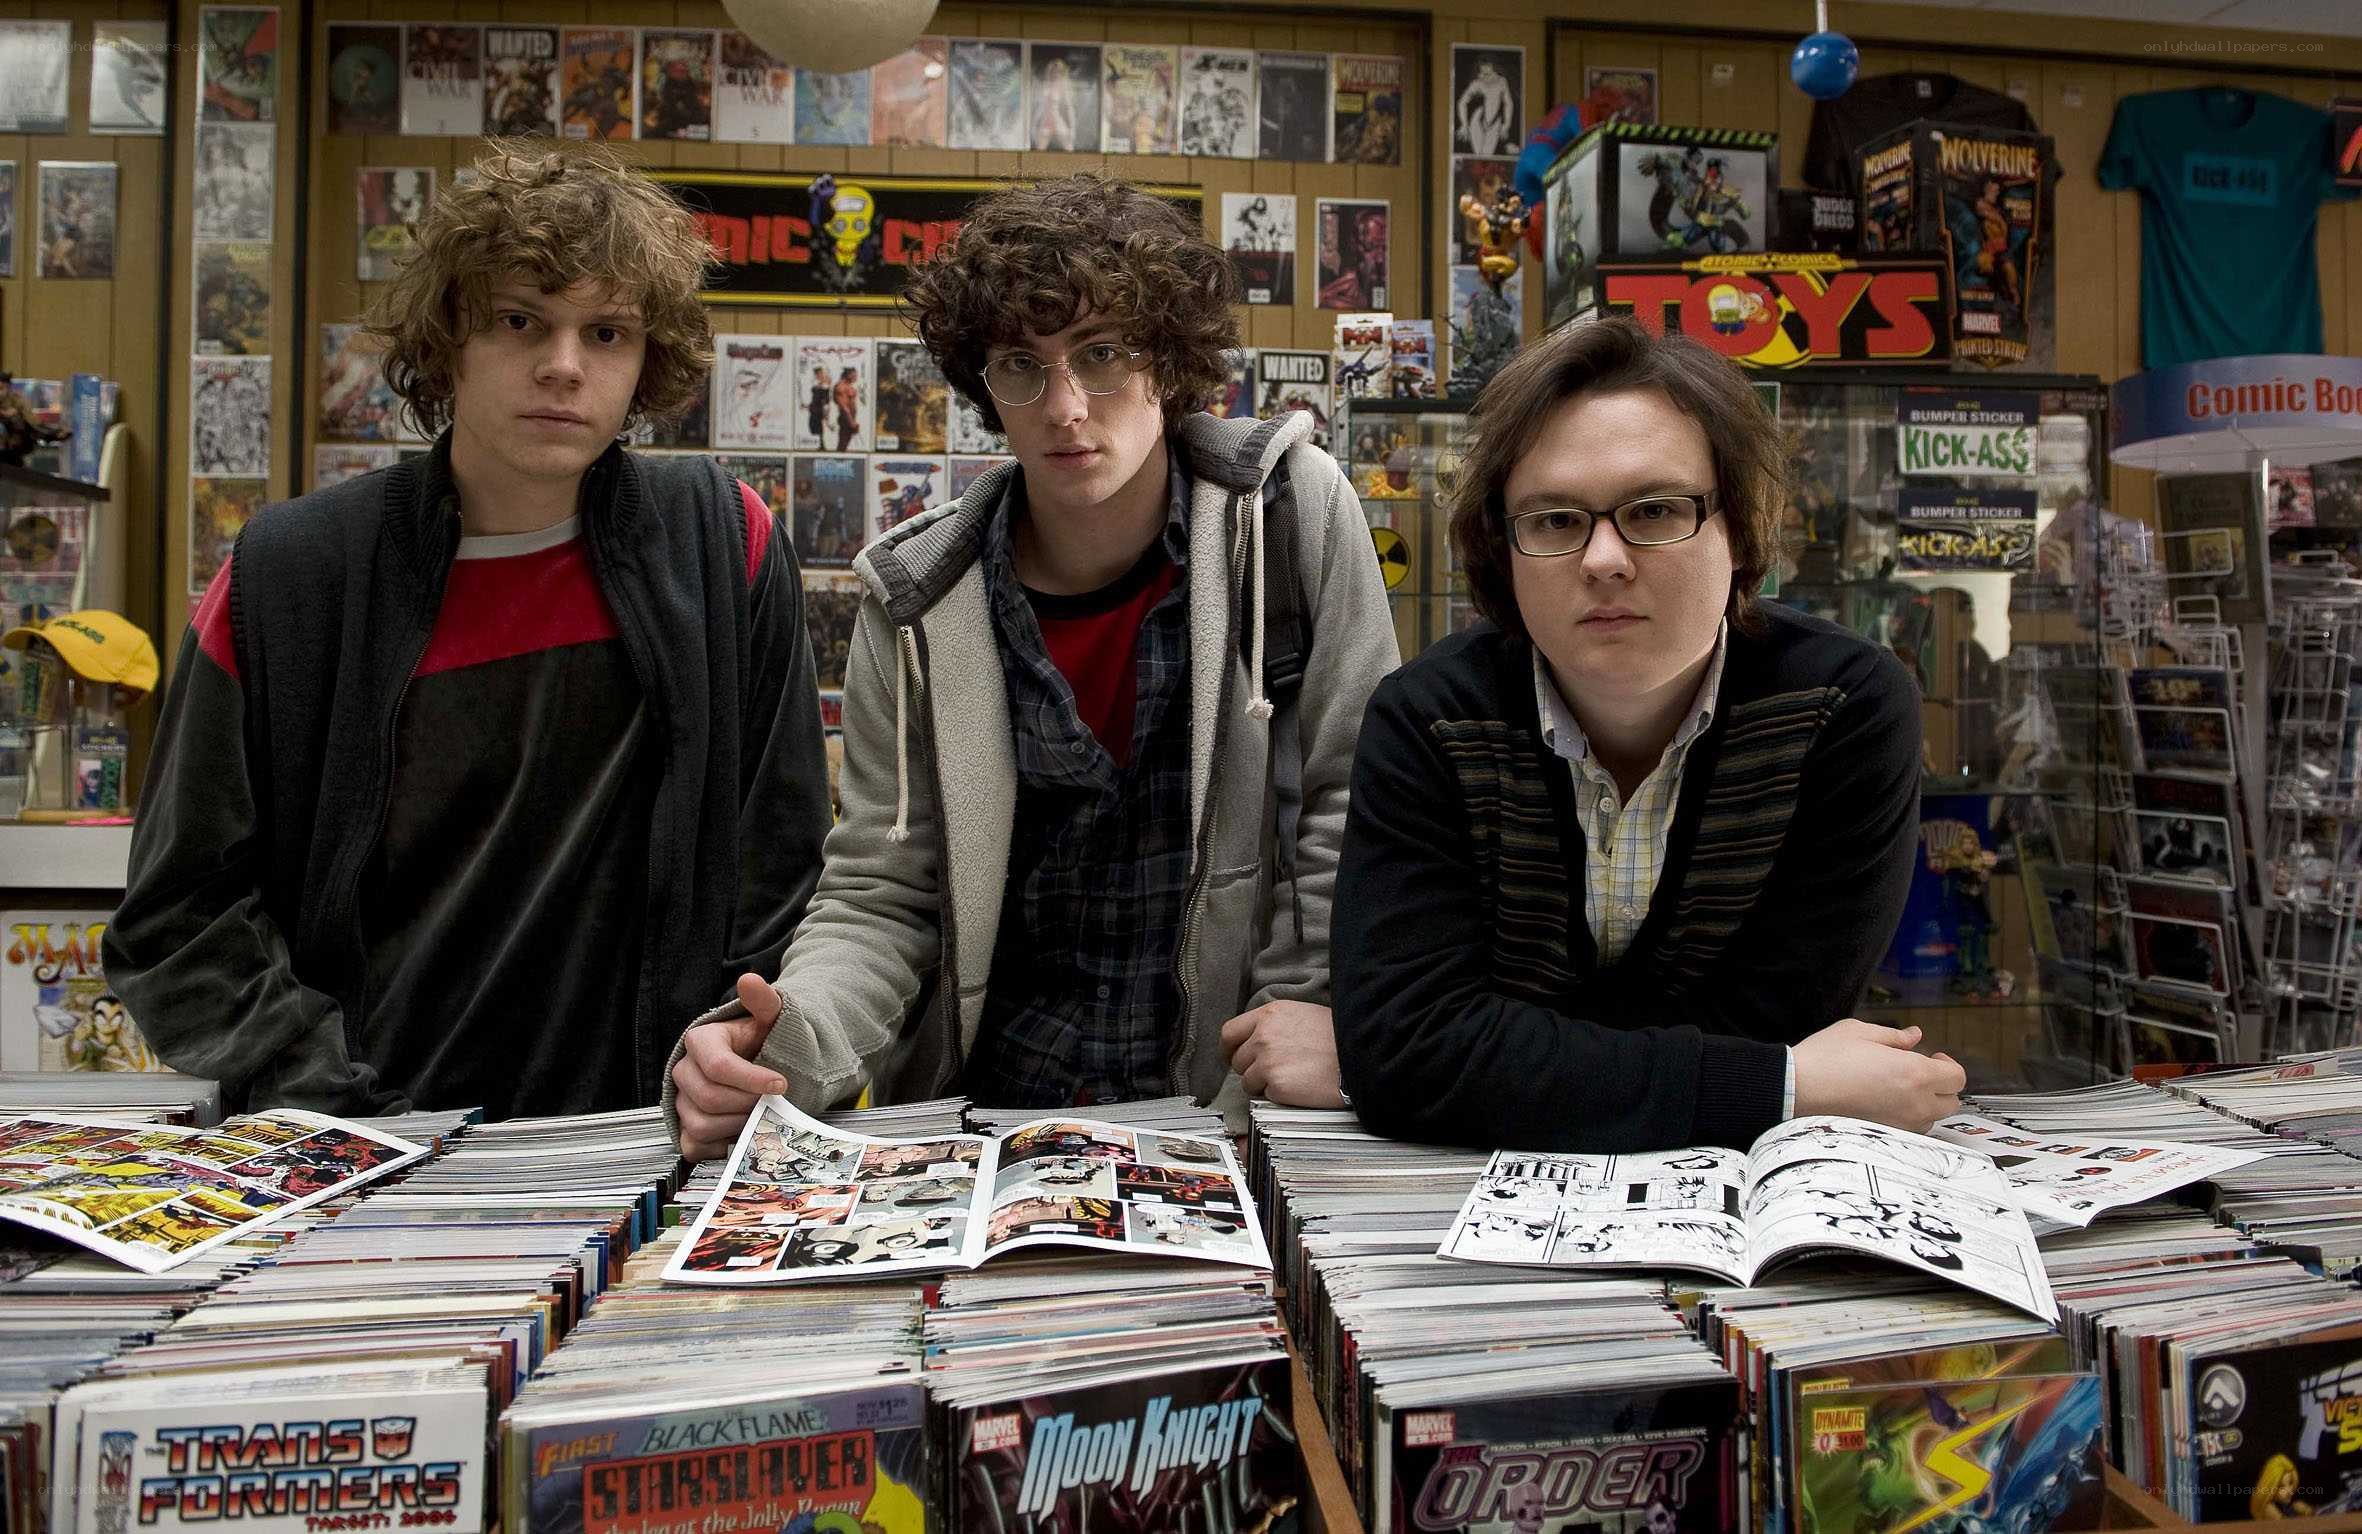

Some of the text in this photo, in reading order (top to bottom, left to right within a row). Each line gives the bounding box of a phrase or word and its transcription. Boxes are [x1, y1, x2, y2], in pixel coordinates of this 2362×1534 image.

[1940, 136, 2038, 178] WOLVERINE
[694, 212, 812, 265] MIC
[1703, 252, 1836, 268] ATOMIC COMICS
[1605, 271, 1940, 361] TOYS
[1962, 313, 2001, 333] MARVEL
[1263, 354, 1325, 382] WANTED
[1910, 409, 2025, 423] BUMPER STICKER
[2187, 377, 2307, 418] Comic
[1904, 425, 2029, 473] KICK-ASS
[1910, 506, 2023, 519] BUMPER STICKER
[642, 1410, 823, 1453] BLACK FLAME
[975, 1414, 1020, 1442] MARVEL
[1406, 1413, 1453, 1435] MARVEL
[1815, 1409, 1864, 1431] DYNAMITE
[157, 1416, 366, 1473] TRANS
[537, 1430, 619, 1478] FIRST
[138, 1460, 463, 1525] FORMERS
[592, 1434, 869, 1522] STARSLAYER
[1414, 1442, 1706, 1532] ORDER
[702, 1509, 738, 1533] the
[740, 1502, 793, 1532] Jolly
